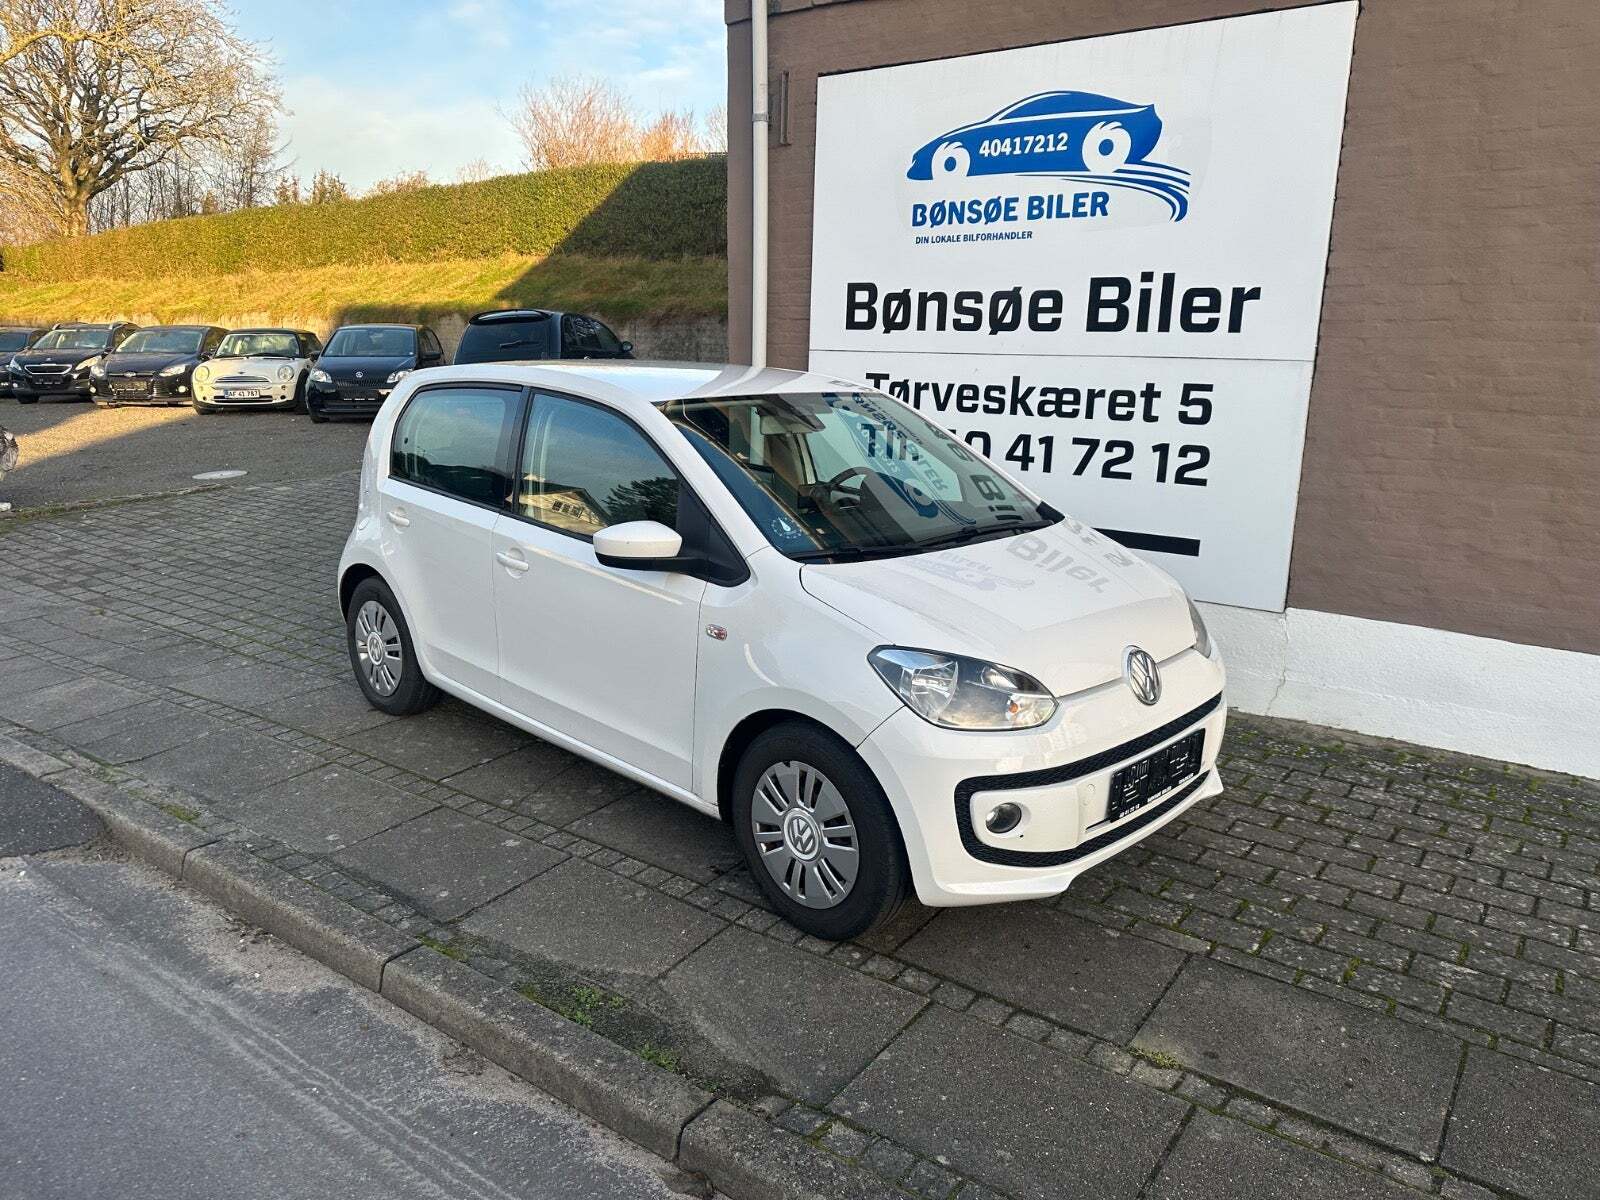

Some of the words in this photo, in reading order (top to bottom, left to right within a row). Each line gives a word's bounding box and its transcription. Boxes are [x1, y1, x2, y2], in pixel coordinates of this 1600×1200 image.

[979, 132, 1068, 157] 40417212
[911, 196, 1019, 229] BØNSØE
[1027, 191, 1110, 221] BILER
[915, 235, 930, 245] DIN
[931, 233, 962, 244] LOKALE
[963, 230, 1033, 242] BILFORHANDLER
[846, 283, 1063, 335] Bønsøe
[1086, 272, 1261, 333] Biler
[866, 373, 1161, 423] Tørveskæret
[1179, 383, 1213, 426] 5
[1006, 434, 1053, 473] 41
[1072, 438, 1134, 480] 72
[1152, 443, 1210, 486] 12
